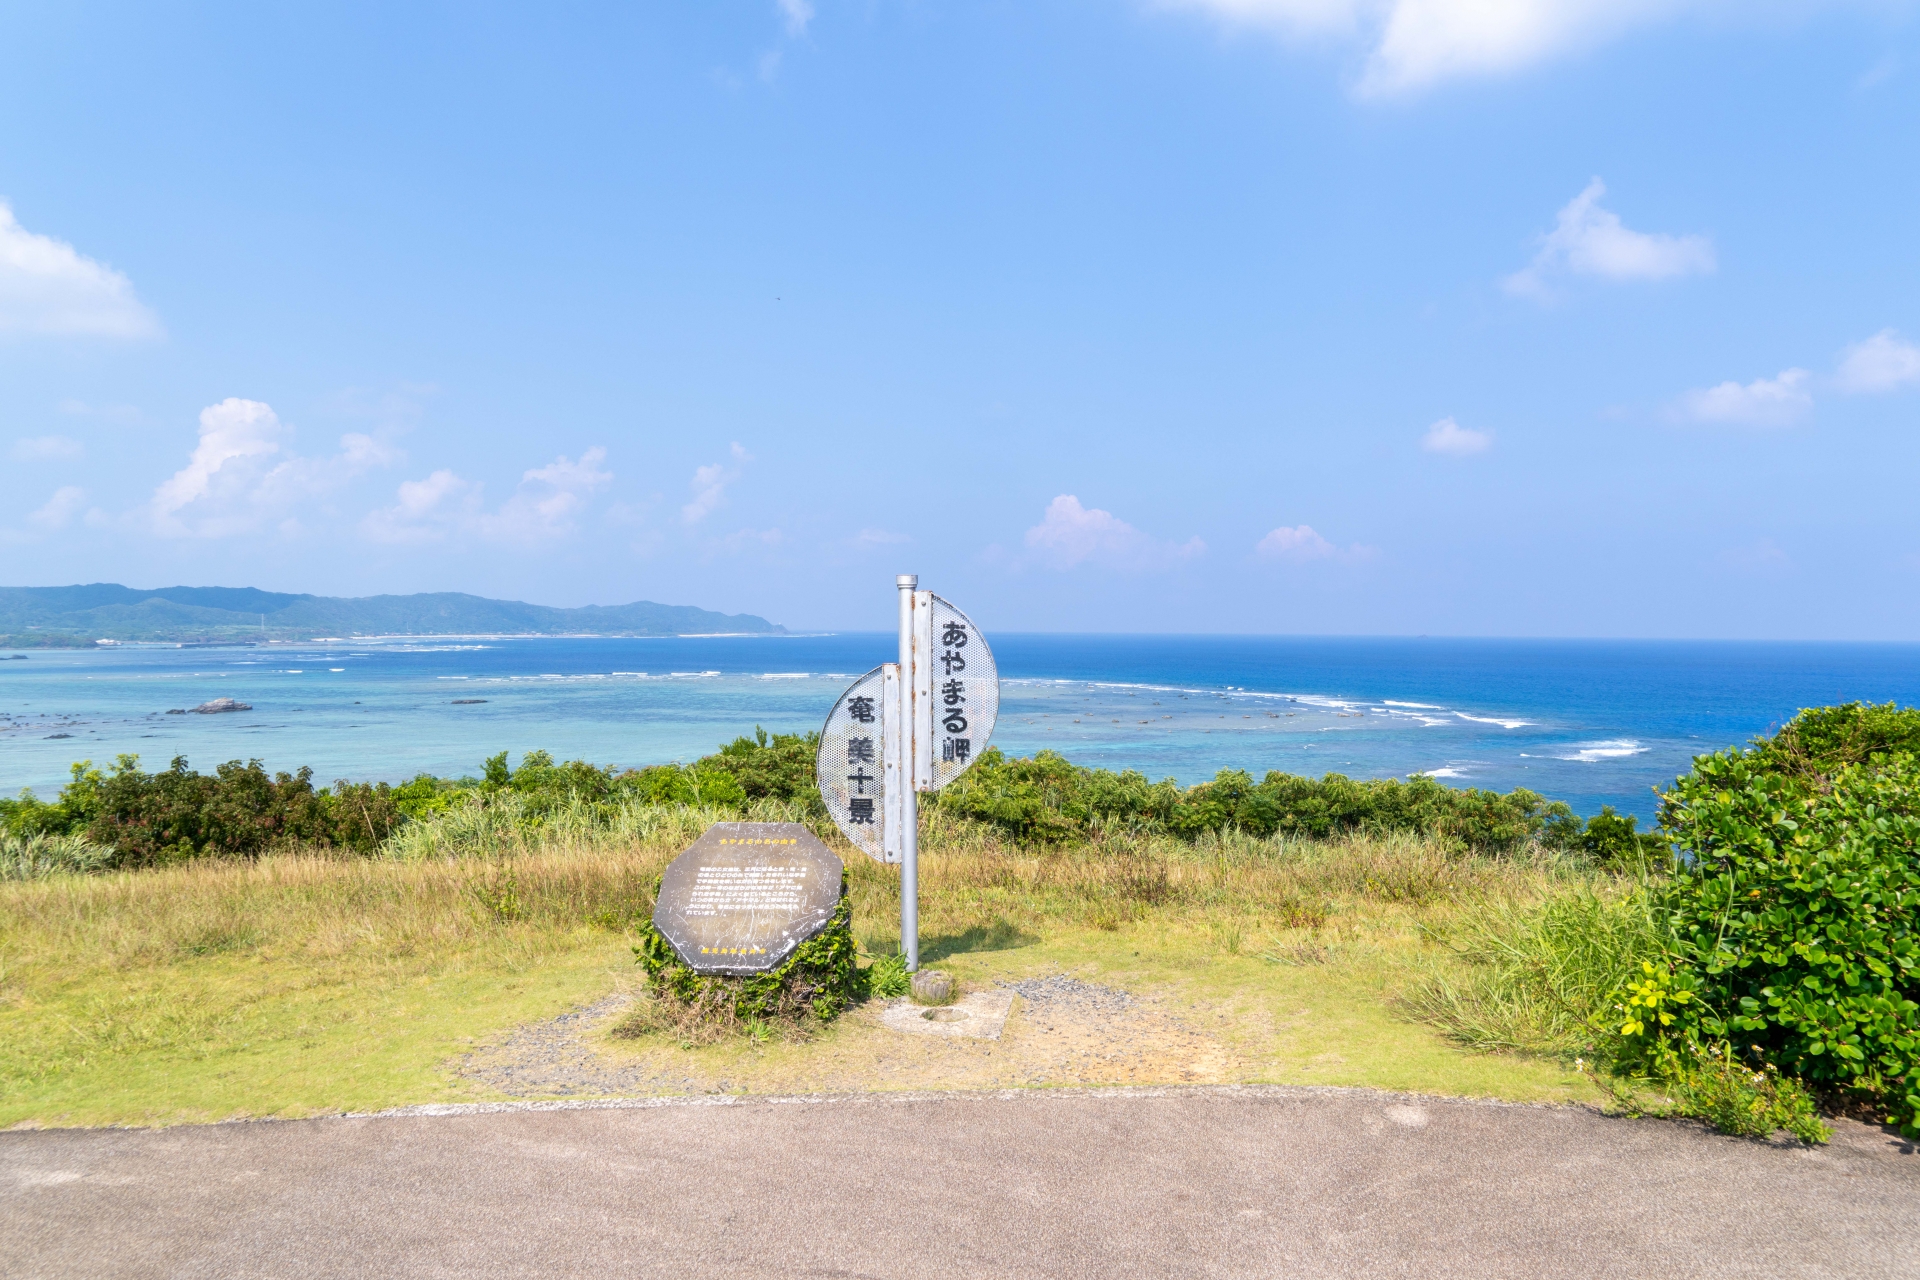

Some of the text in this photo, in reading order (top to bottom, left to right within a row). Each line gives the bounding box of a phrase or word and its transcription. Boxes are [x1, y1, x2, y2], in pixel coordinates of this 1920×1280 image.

[940, 620, 970, 764] あやまる岬
[847, 696, 875, 825] 奄美十景
